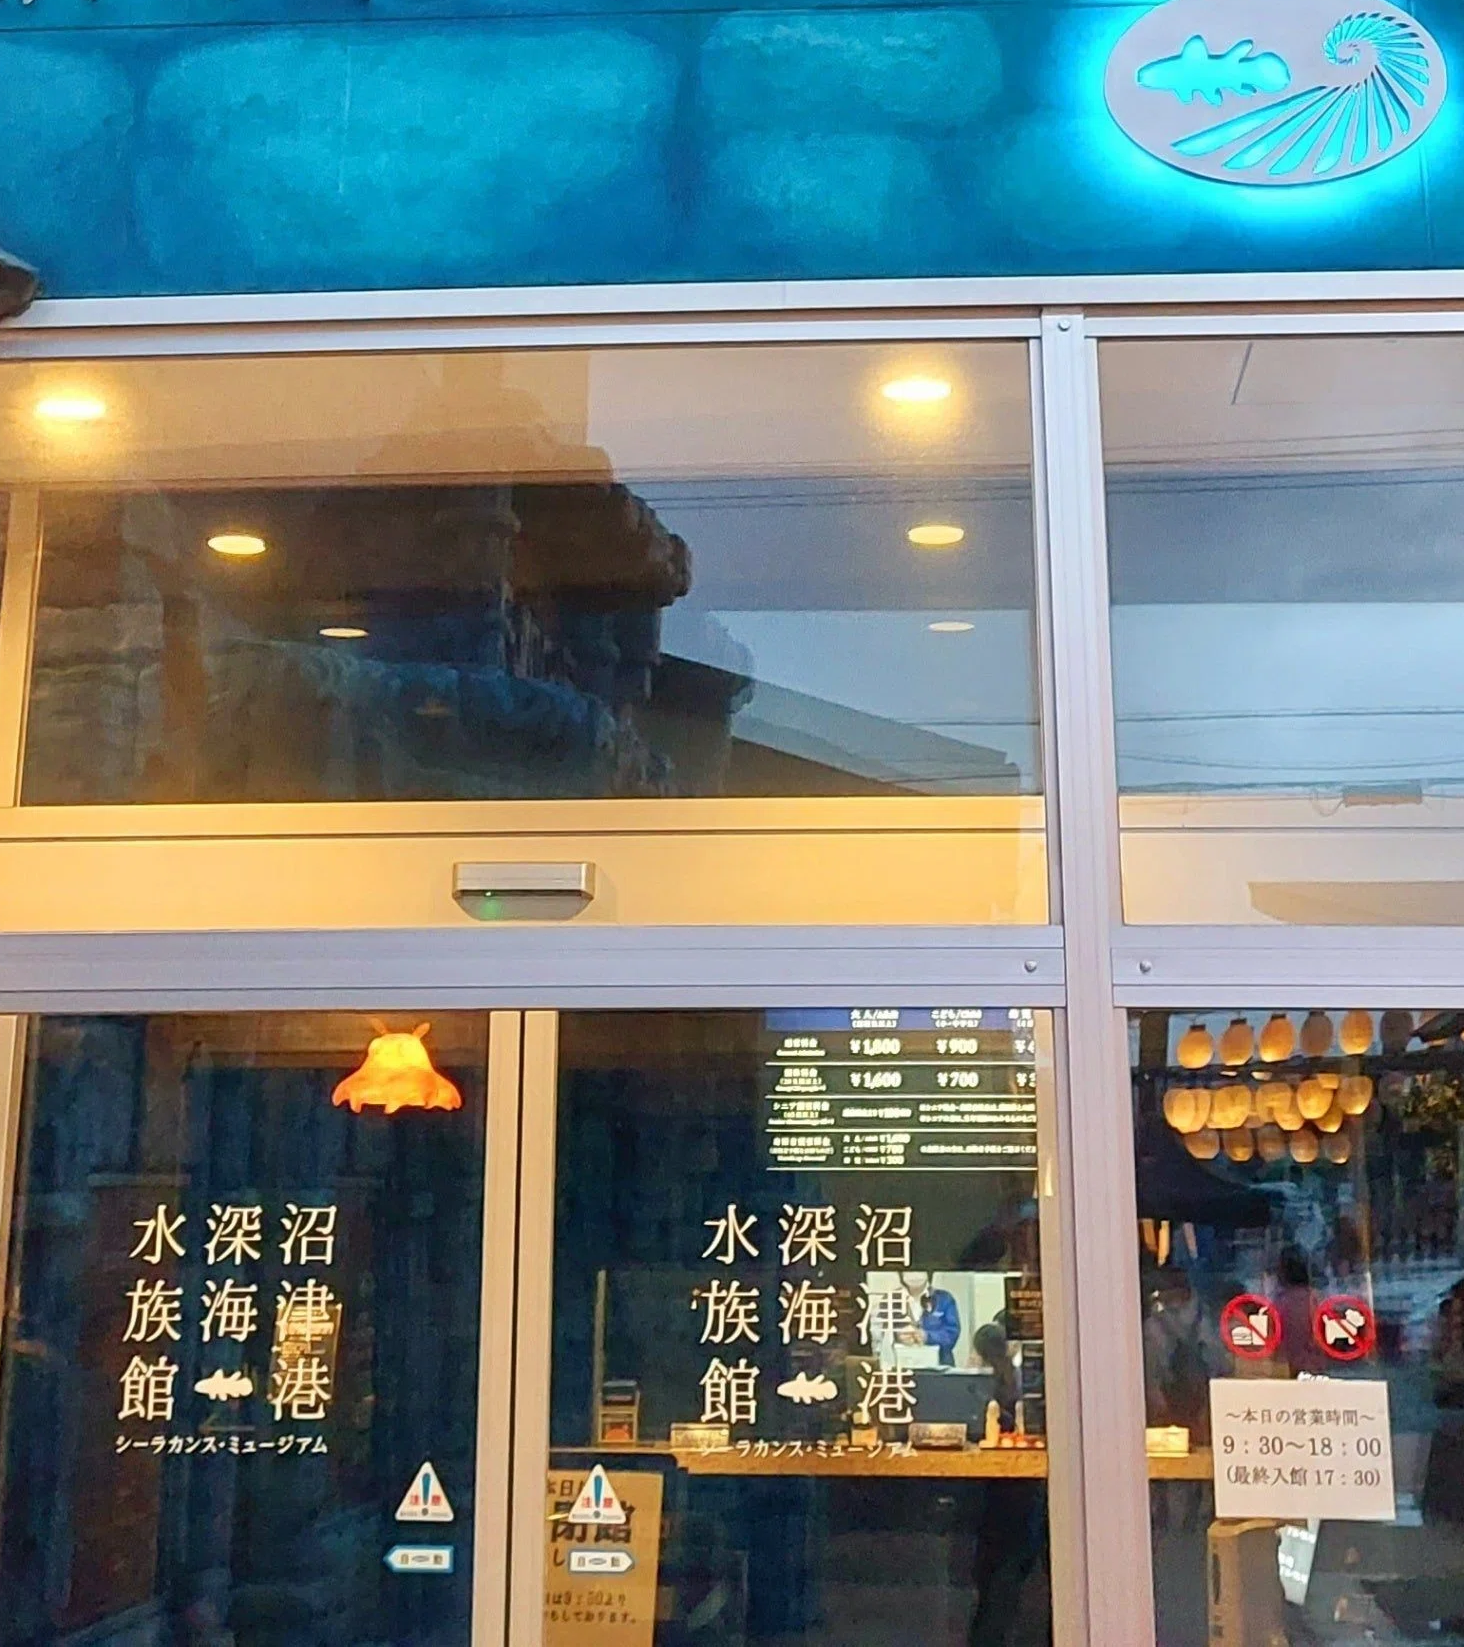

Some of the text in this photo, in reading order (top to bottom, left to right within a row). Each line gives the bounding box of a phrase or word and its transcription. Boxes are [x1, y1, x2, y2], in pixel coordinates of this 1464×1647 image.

[937, 1071, 979, 1088] ¥700
[117, 1203, 186, 1421] 水族館
[199, 1203, 264, 1343] 深海
[699, 1203, 761, 1426] 水族館
[777, 1203, 838, 1346] 深海
